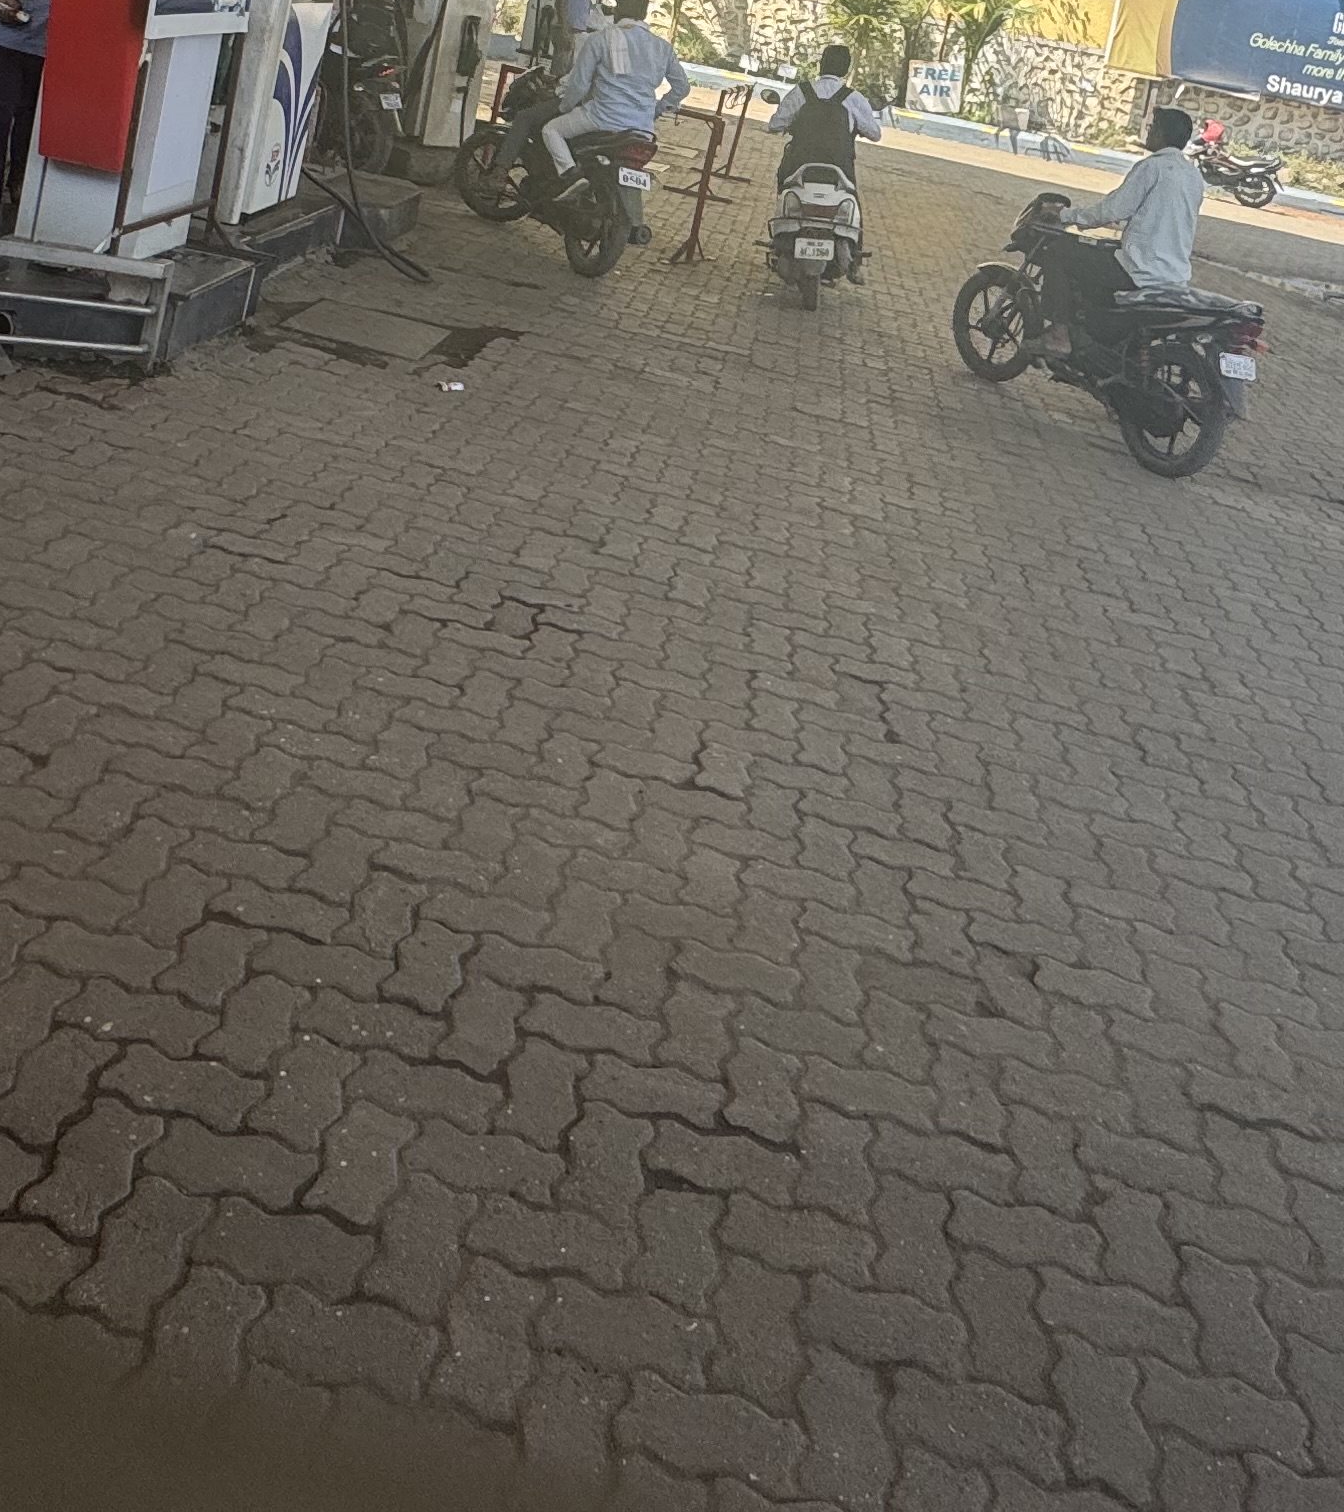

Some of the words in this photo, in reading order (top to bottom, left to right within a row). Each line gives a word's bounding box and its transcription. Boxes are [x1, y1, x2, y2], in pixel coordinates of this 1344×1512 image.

[912, 66, 960, 82] FREE
[1302, 63, 1335, 79] more
[919, 84, 951, 98] AIR
[1266, 74, 1344, 105] Shaurya
